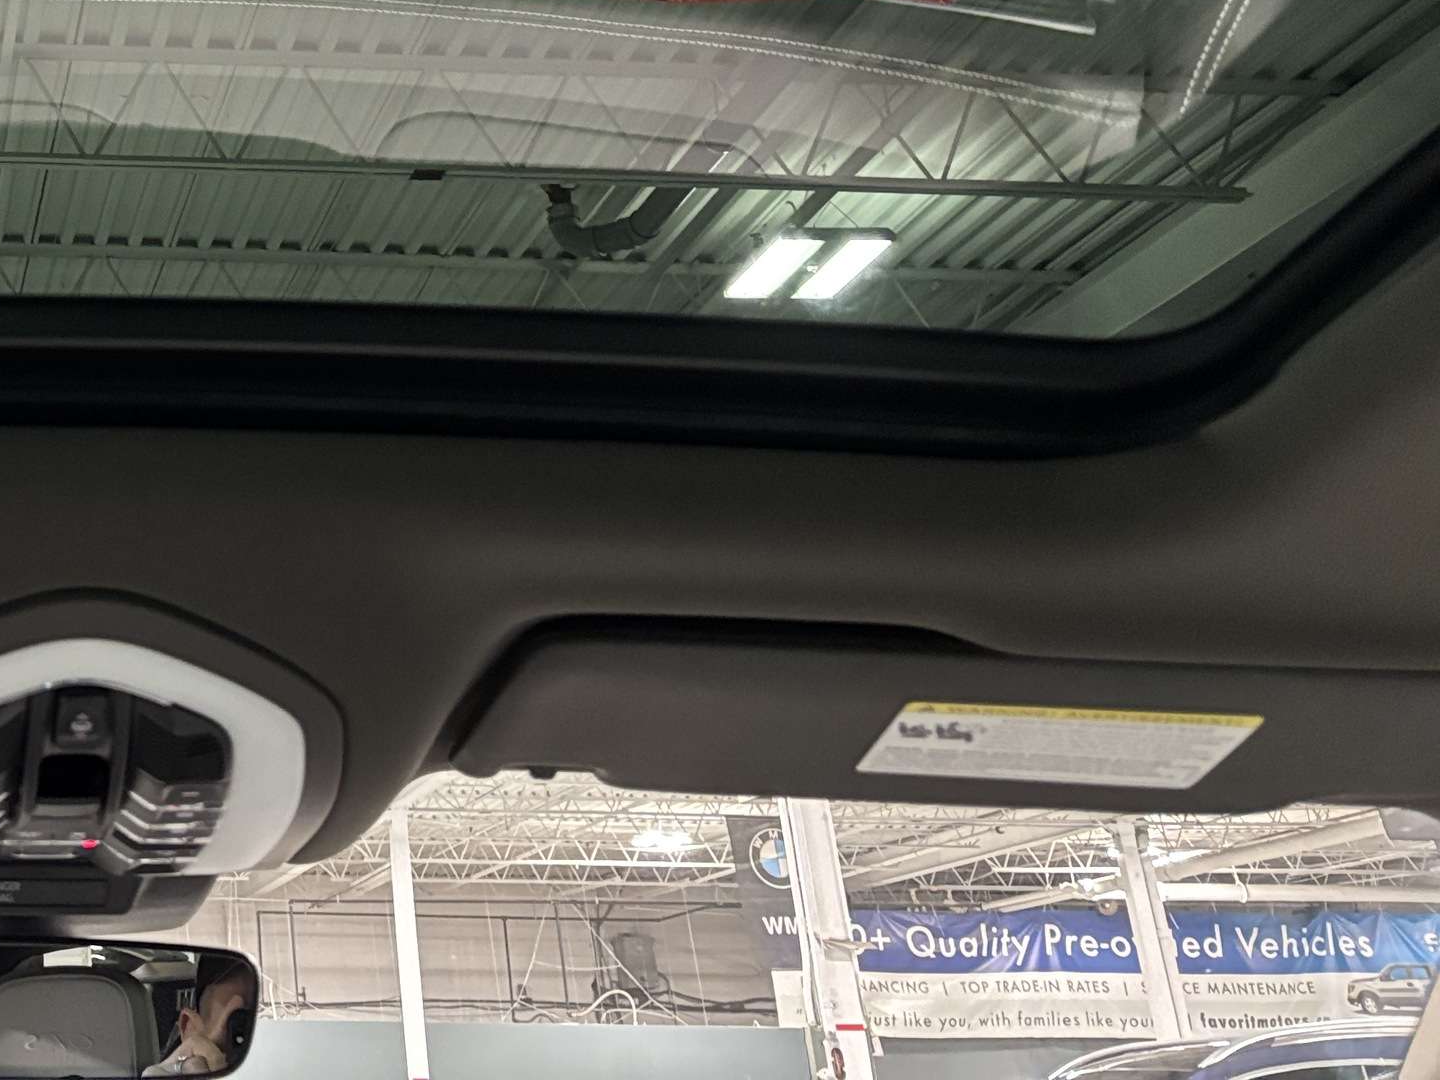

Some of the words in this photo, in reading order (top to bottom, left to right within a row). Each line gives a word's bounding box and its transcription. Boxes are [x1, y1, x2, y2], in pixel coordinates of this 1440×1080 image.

[906, 923, 1030, 966] Quality
[1044, 923, 1223, 958] Pre-oed
[1234, 921, 1375, 959] Vehicles
[861, 980, 929, 994] NANCING
[959, 981, 989, 995] TOP
[995, 980, 1060, 995] TRADE-IN
[1068, 980, 1110, 994] RATES
[1207, 981, 1316, 996] MAINTENANCE
[903, 1011, 932, 1028] like
[979, 1011, 1010, 1028] with
[1017, 1010, 1081, 1028] families
[1085, 1010, 1113, 1028] like
[1119, 1015, 1154, 1032] you
